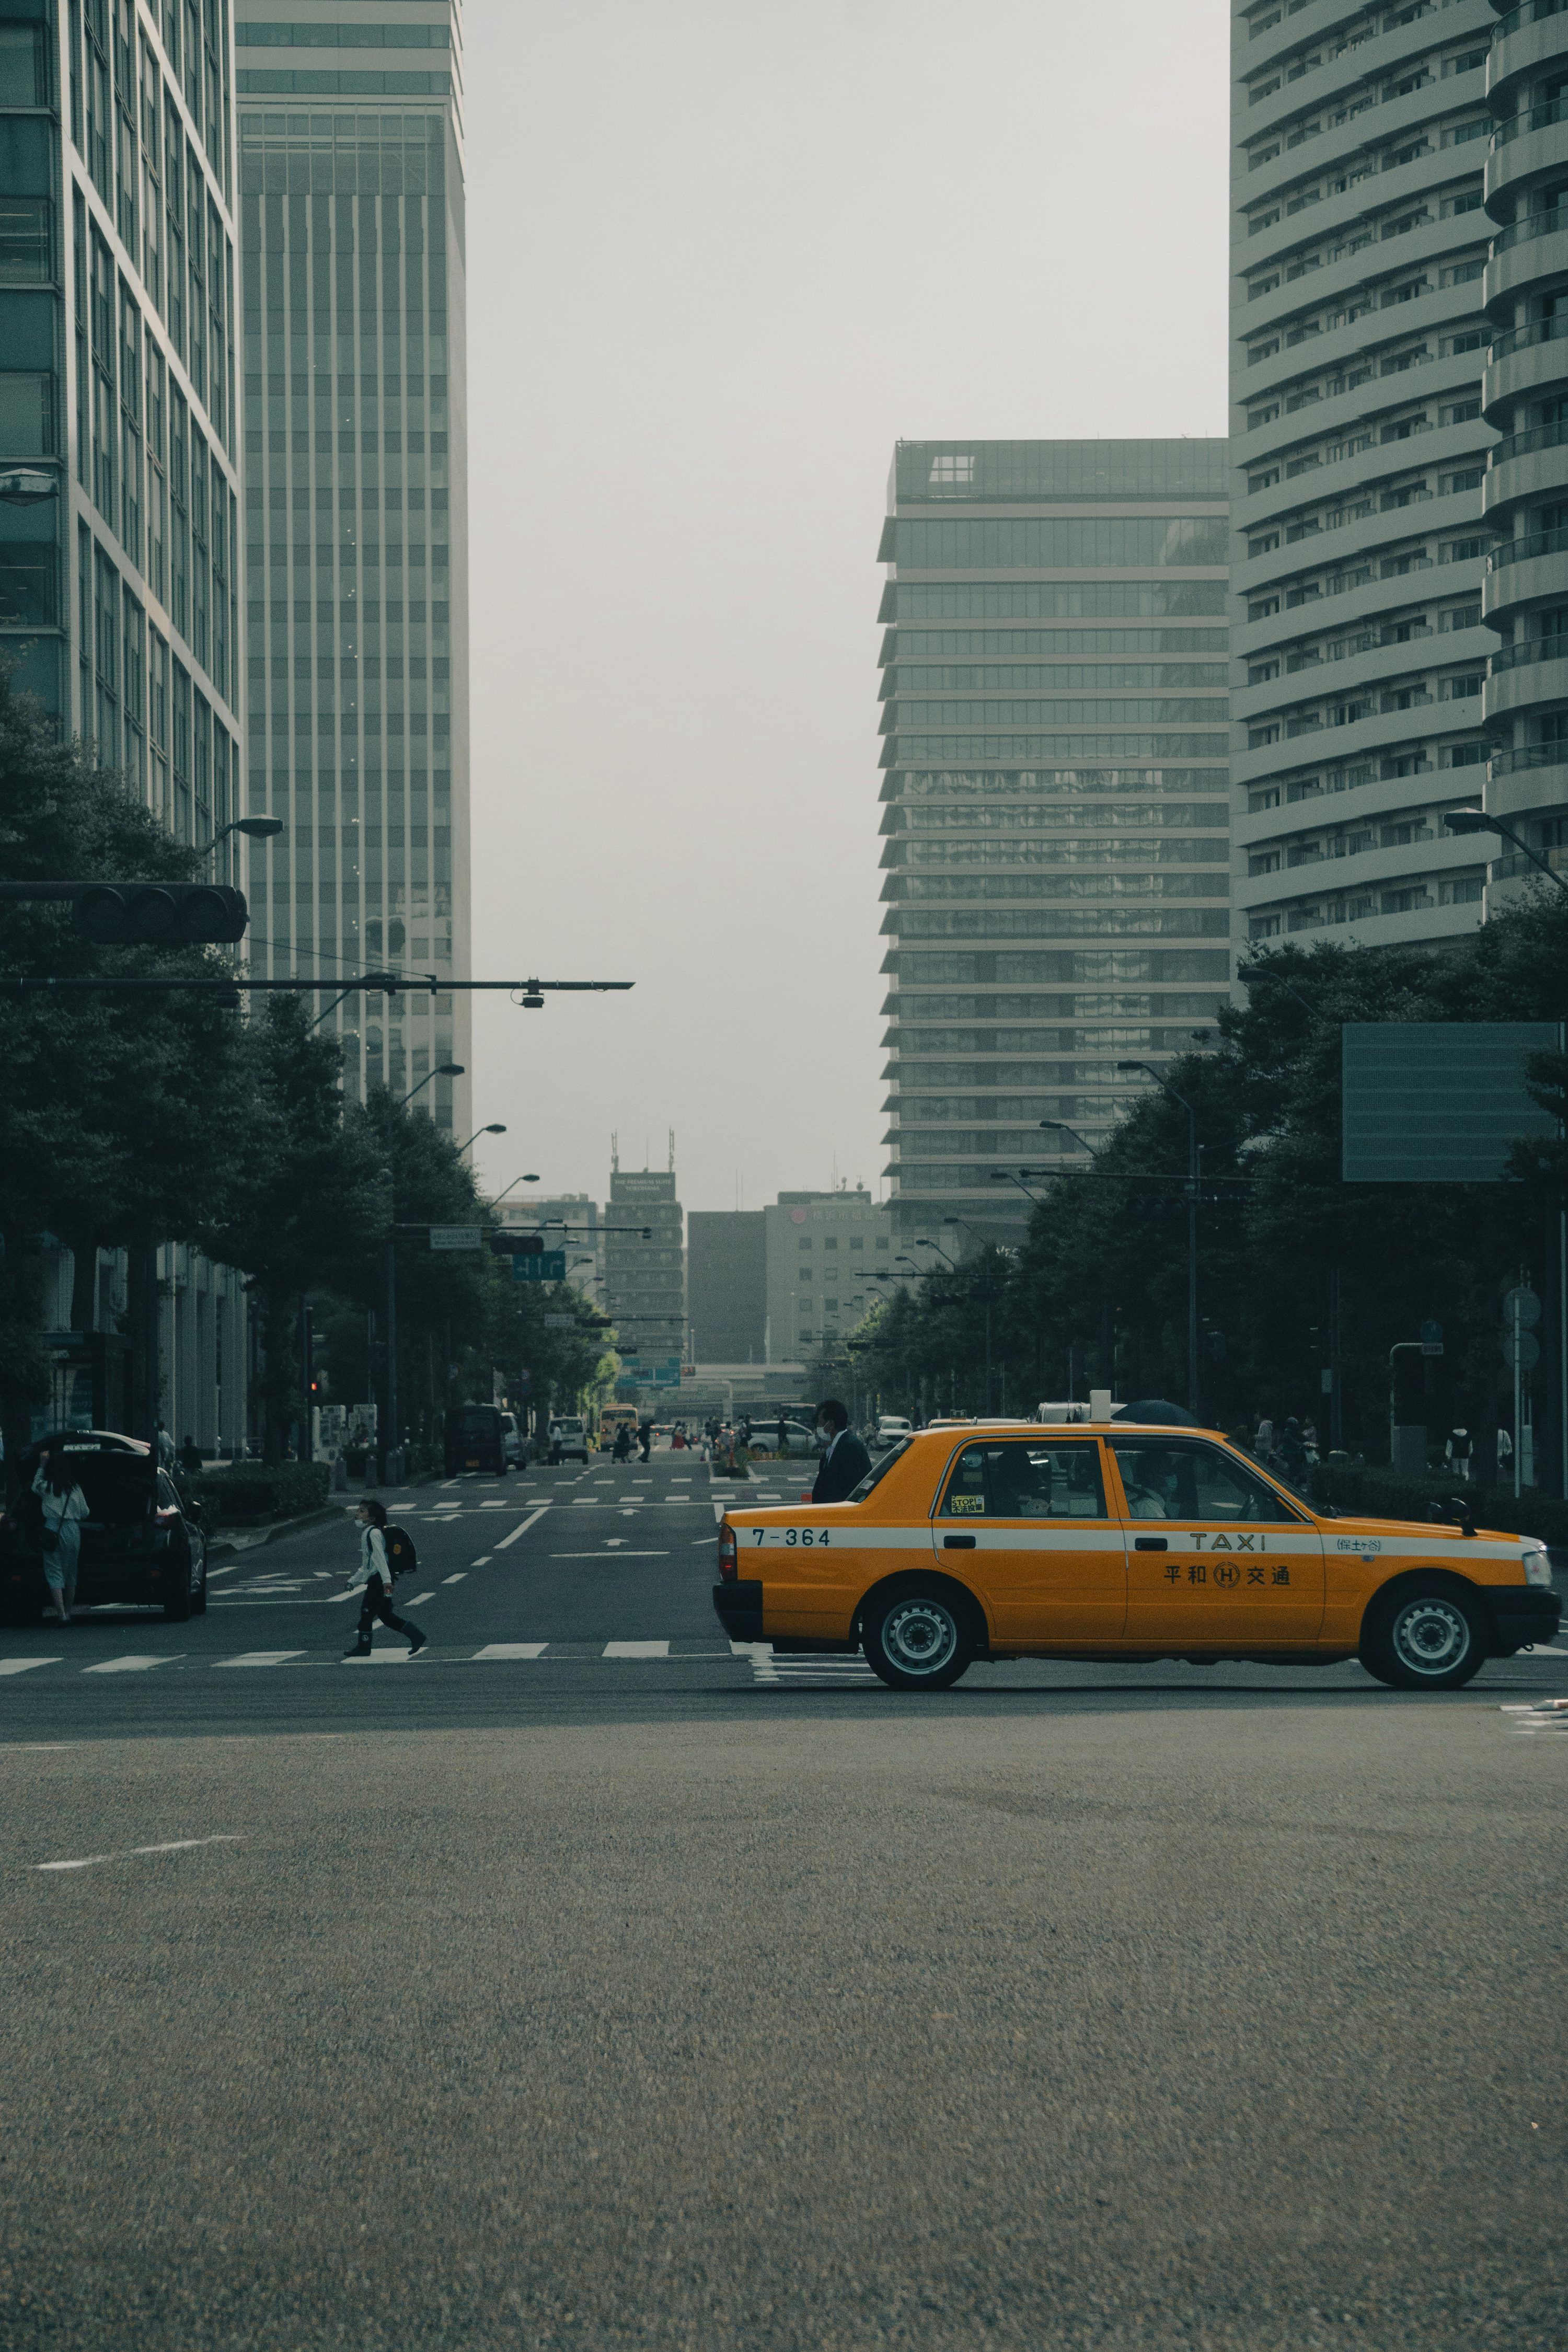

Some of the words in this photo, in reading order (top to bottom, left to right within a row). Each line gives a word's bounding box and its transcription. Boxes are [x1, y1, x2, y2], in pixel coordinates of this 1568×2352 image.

[952, 1497, 976, 1506] STOP!
[753, 1529, 830, 1546] 7-364
[1190, 1533, 1265, 1551] TAXI
[1163, 1565, 1206, 1584] 平和
[1247, 1565, 1290, 1585] 交通
